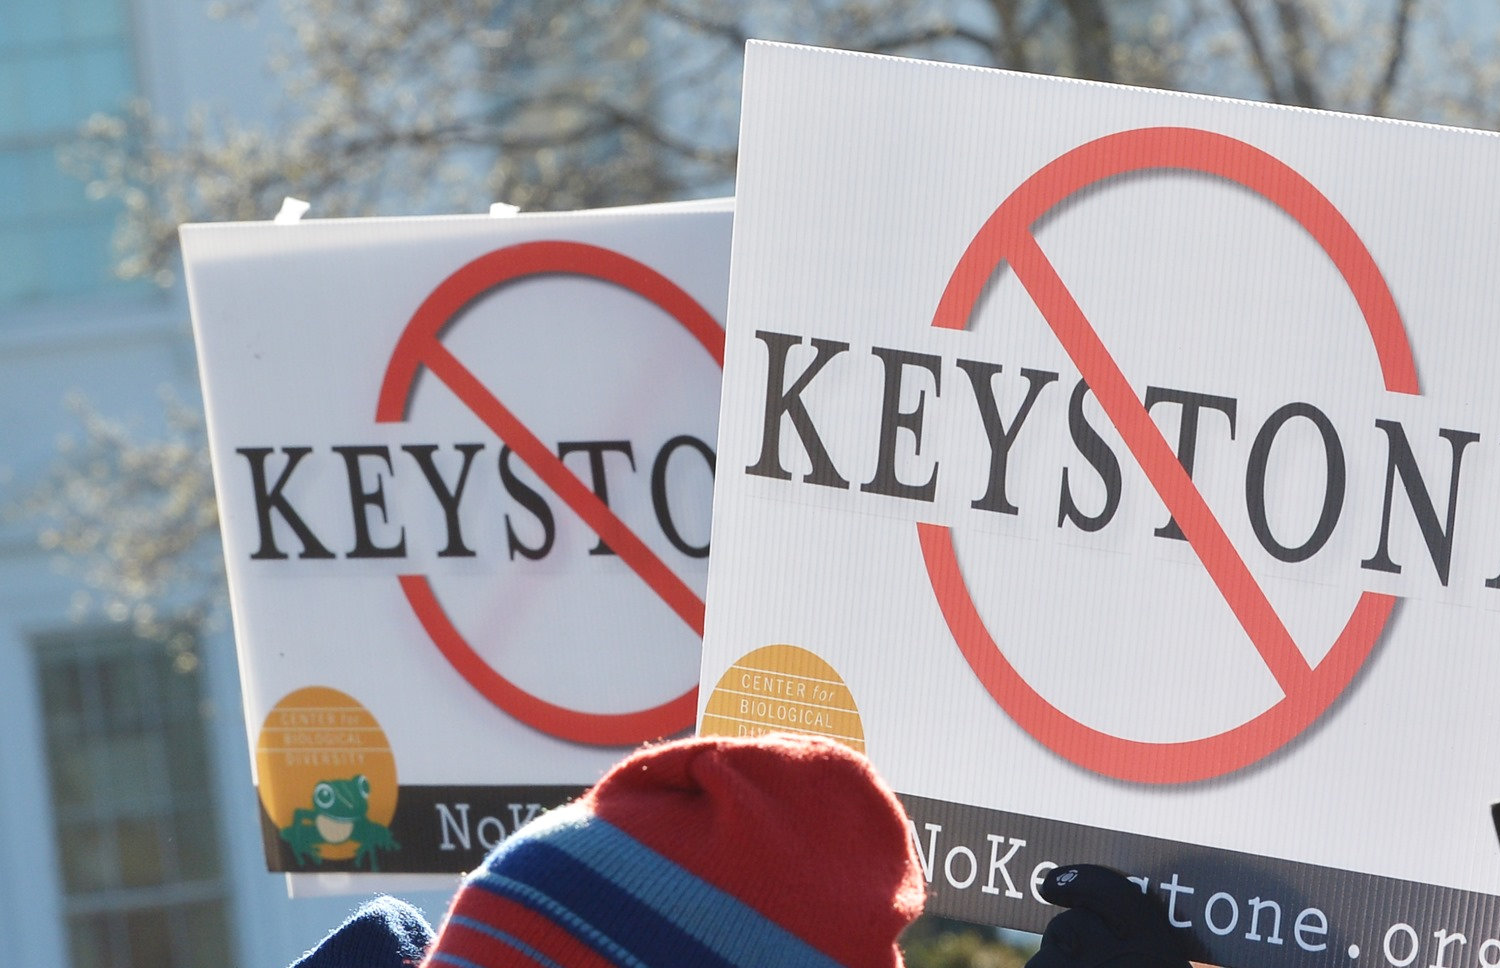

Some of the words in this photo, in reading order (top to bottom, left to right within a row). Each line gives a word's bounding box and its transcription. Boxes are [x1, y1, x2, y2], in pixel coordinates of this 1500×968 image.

[740, 673, 806, 698] CENTER
[812, 685, 836, 702] for
[740, 699, 833, 729] BIOLOGICAL
